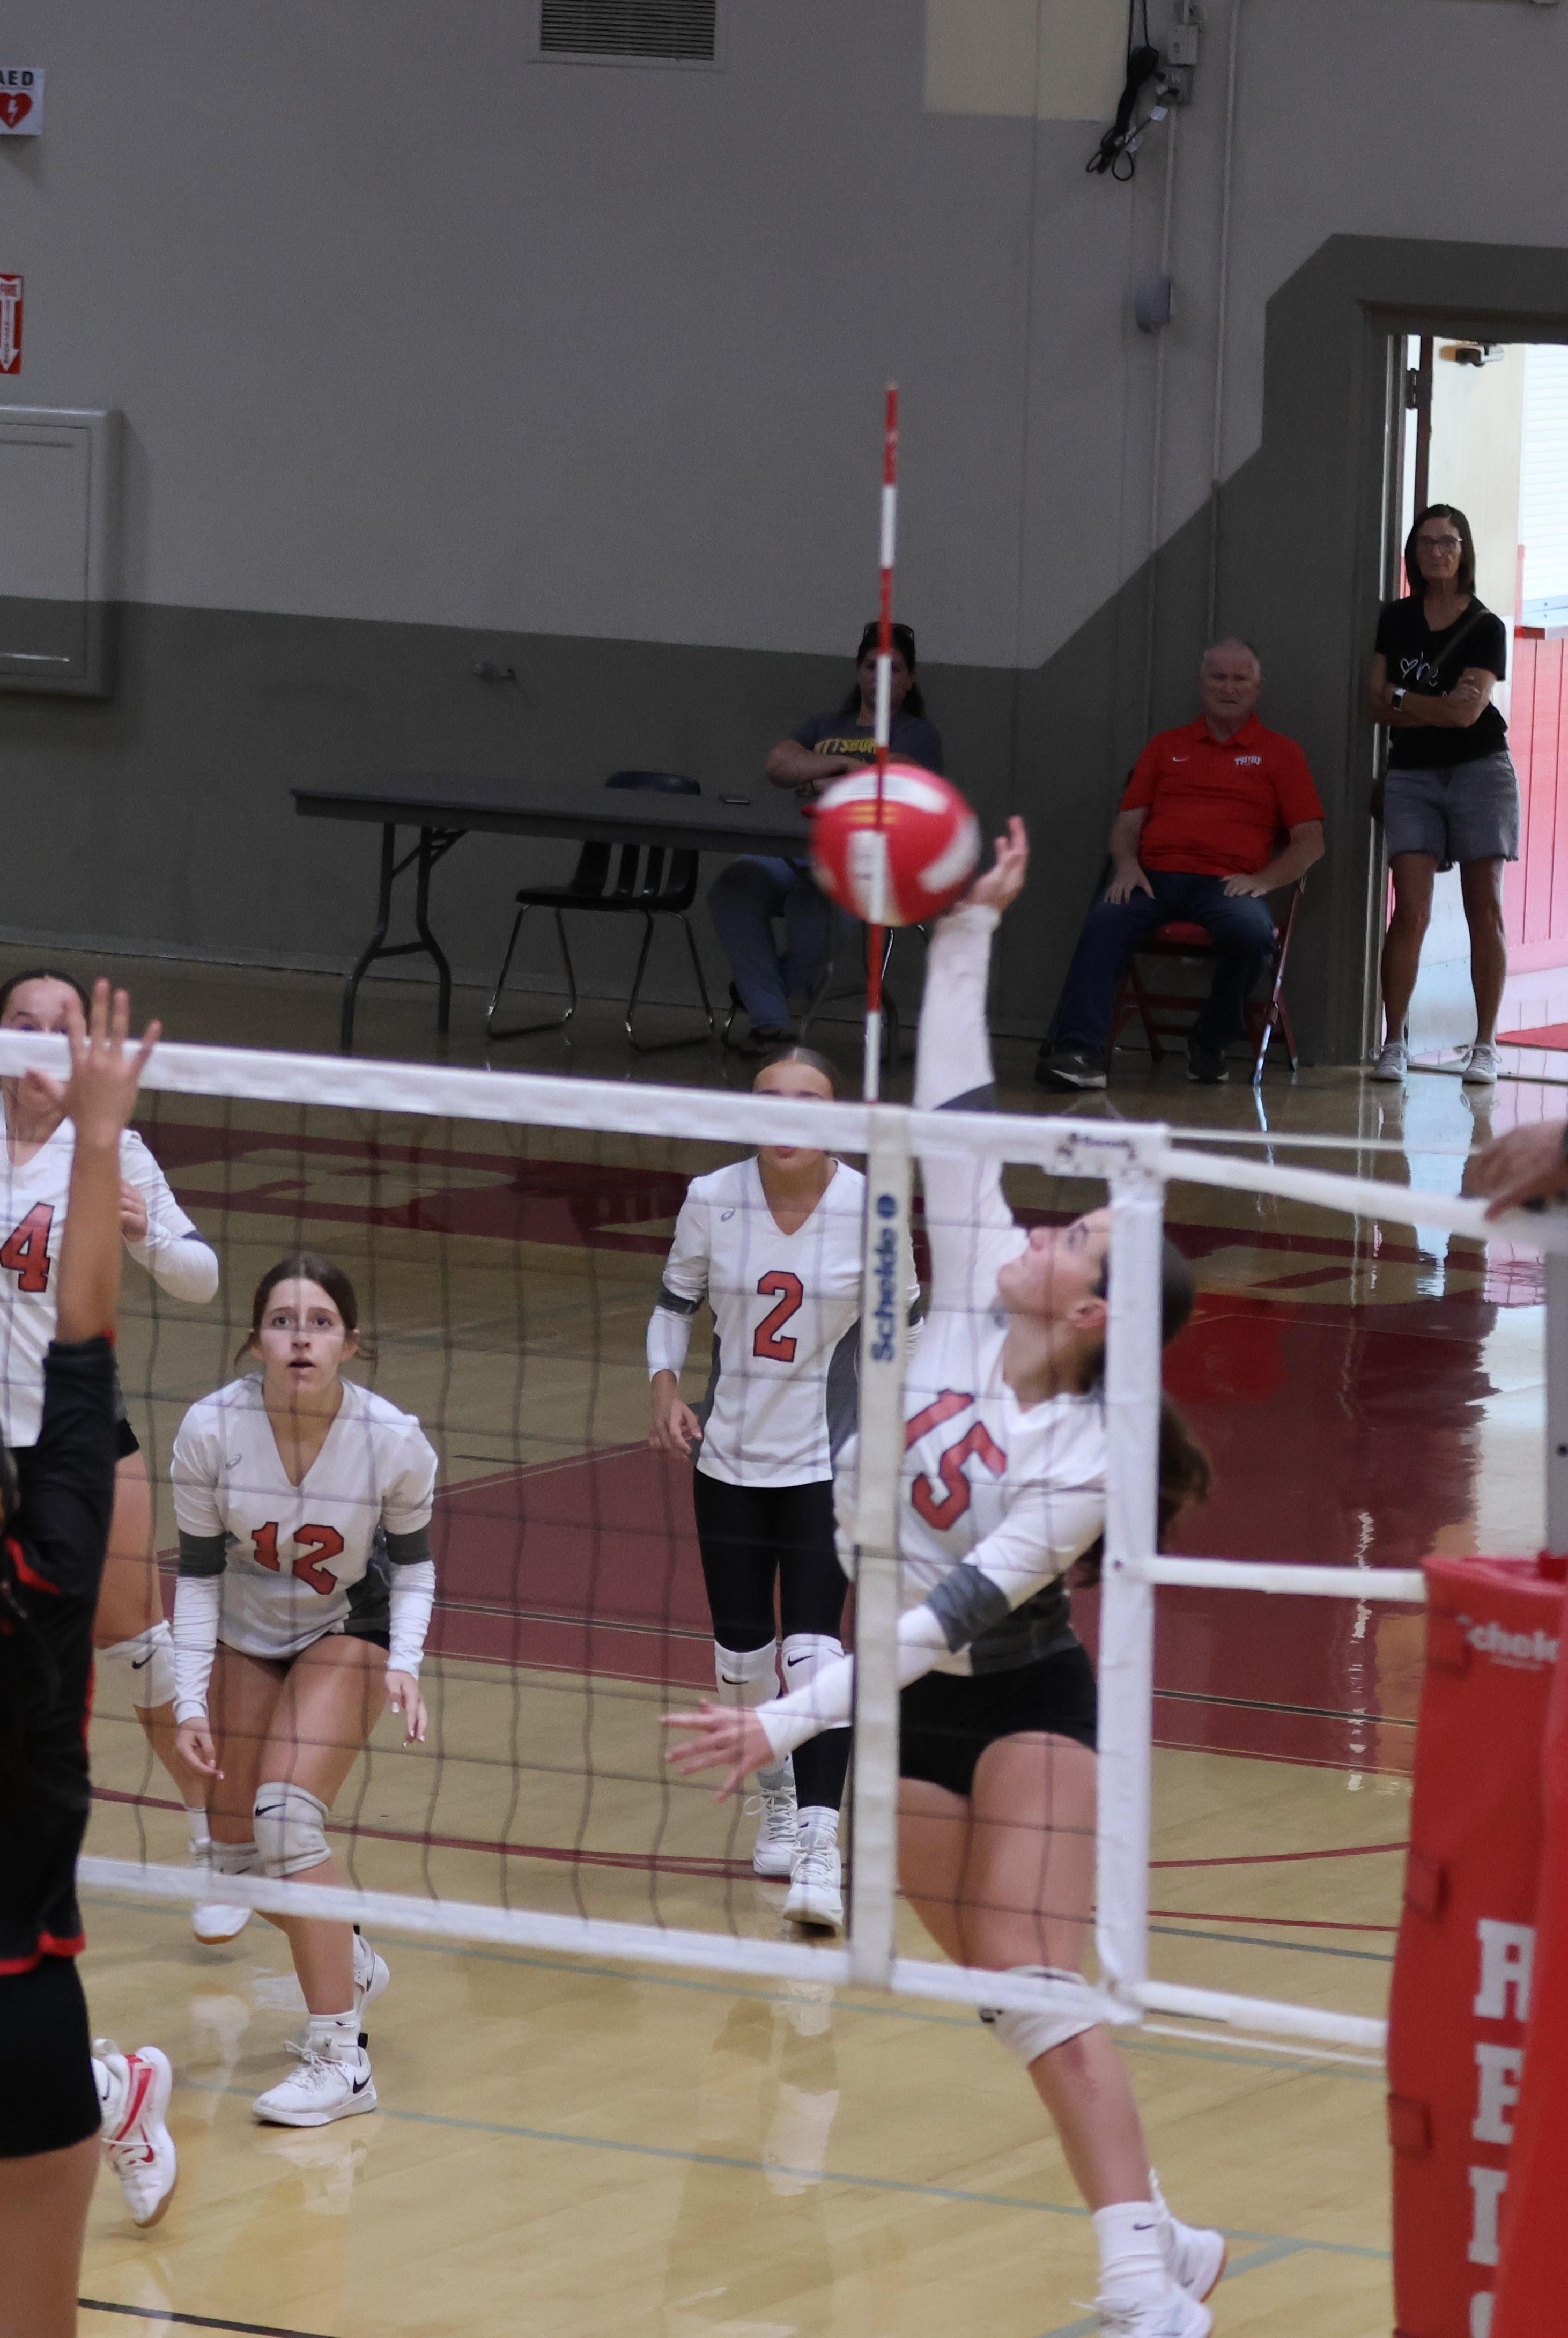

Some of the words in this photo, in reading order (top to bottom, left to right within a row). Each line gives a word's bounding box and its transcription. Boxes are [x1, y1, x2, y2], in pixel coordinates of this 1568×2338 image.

[0, 1201, 55, 1292] 4
[753, 1270, 804, 1363] 2
[906, 1389, 1007, 1530] 15
[251, 1521, 344, 1595] 12
